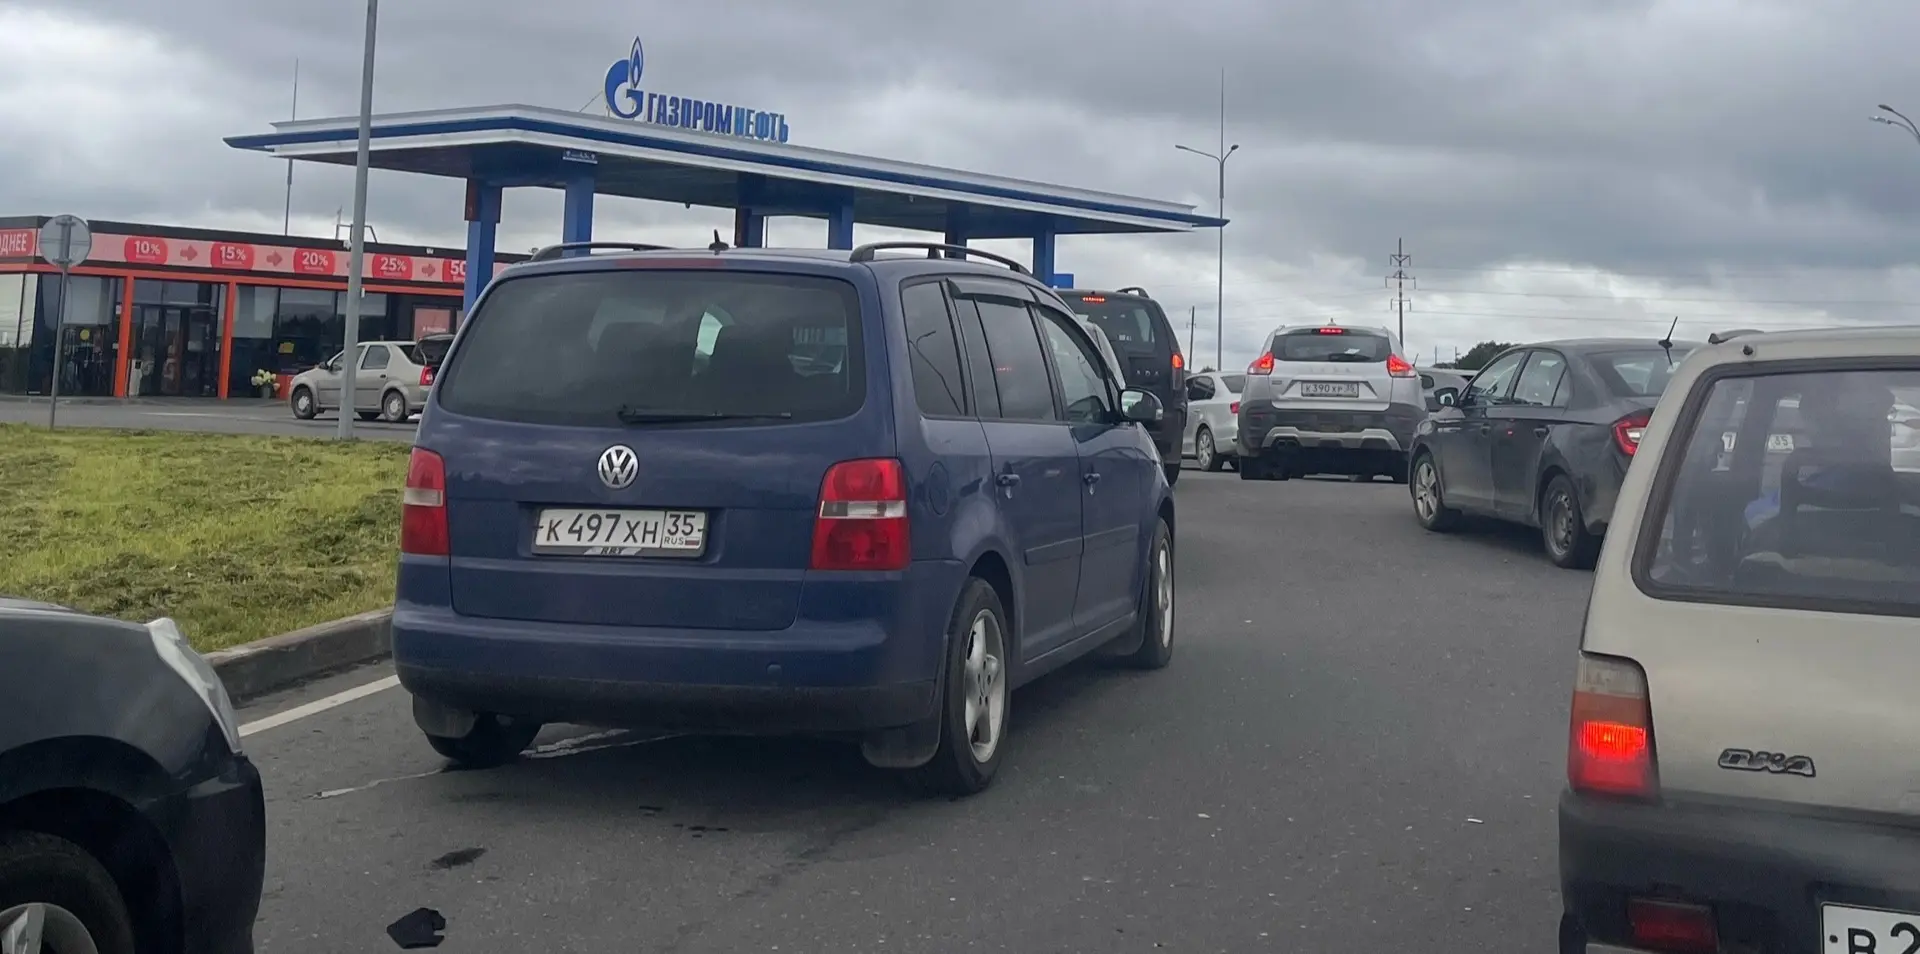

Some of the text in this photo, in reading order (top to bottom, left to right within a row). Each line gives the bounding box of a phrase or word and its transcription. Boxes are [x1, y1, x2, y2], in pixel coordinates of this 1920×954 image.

[647, 92, 789, 143] ГАЗПРОМНЕФТЬ
[0, 232, 28, 256] ДНЕЕ
[134, 240, 161, 256] 10%
[219, 245, 247, 261] 15%
[302, 252, 329, 266] 20%
[379, 257, 407, 271] 25%
[667, 513, 697, 536] 35
[663, 536, 684, 545] RUS
